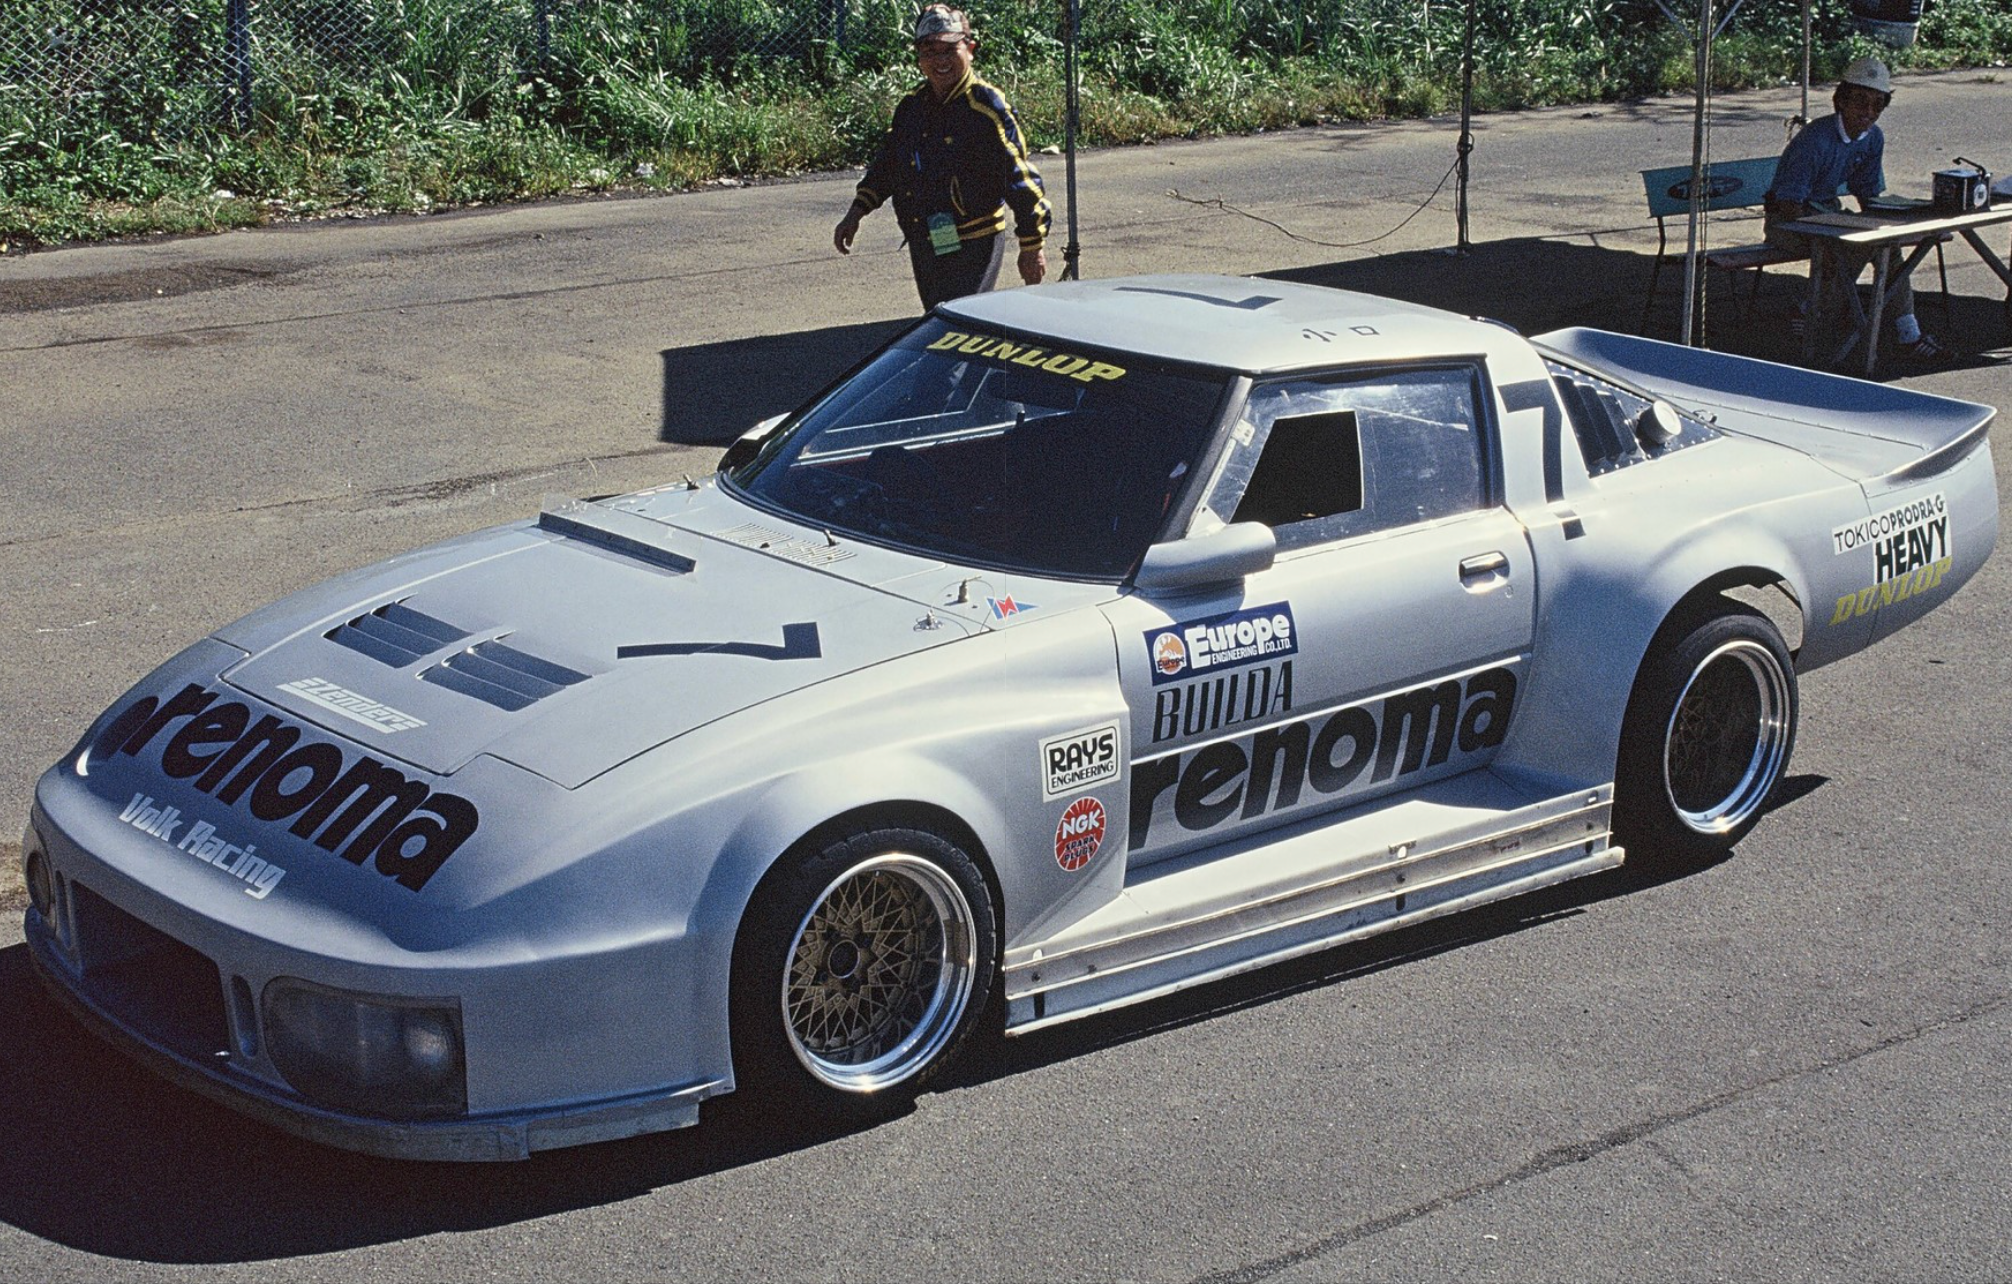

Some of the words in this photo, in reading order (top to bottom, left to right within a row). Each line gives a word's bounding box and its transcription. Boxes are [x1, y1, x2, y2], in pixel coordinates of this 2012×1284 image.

[926, 332, 1127, 382] DUNLOP
[1497, 379, 1565, 503] 7
[1875, 516, 1946, 583] HEAVY
[1830, 557, 1952, 625] DUNLOP
[1184, 614, 1289, 668] Europe
[1212, 645, 1258, 664] ENGINEERING
[1152, 660, 1292, 743] BUILDA
[1049, 733, 1114, 774] RAYS
[1051, 761, 1114, 788] ENGINEERING
[1128, 668, 1517, 850] renoma
[119, 792, 183, 842] Volk
[177, 819, 287, 900] Racing
[1062, 809, 1100, 838] NGK
[1064, 835, 1095, 850] SPARK
[1064, 845, 1094, 862] PLUGS
